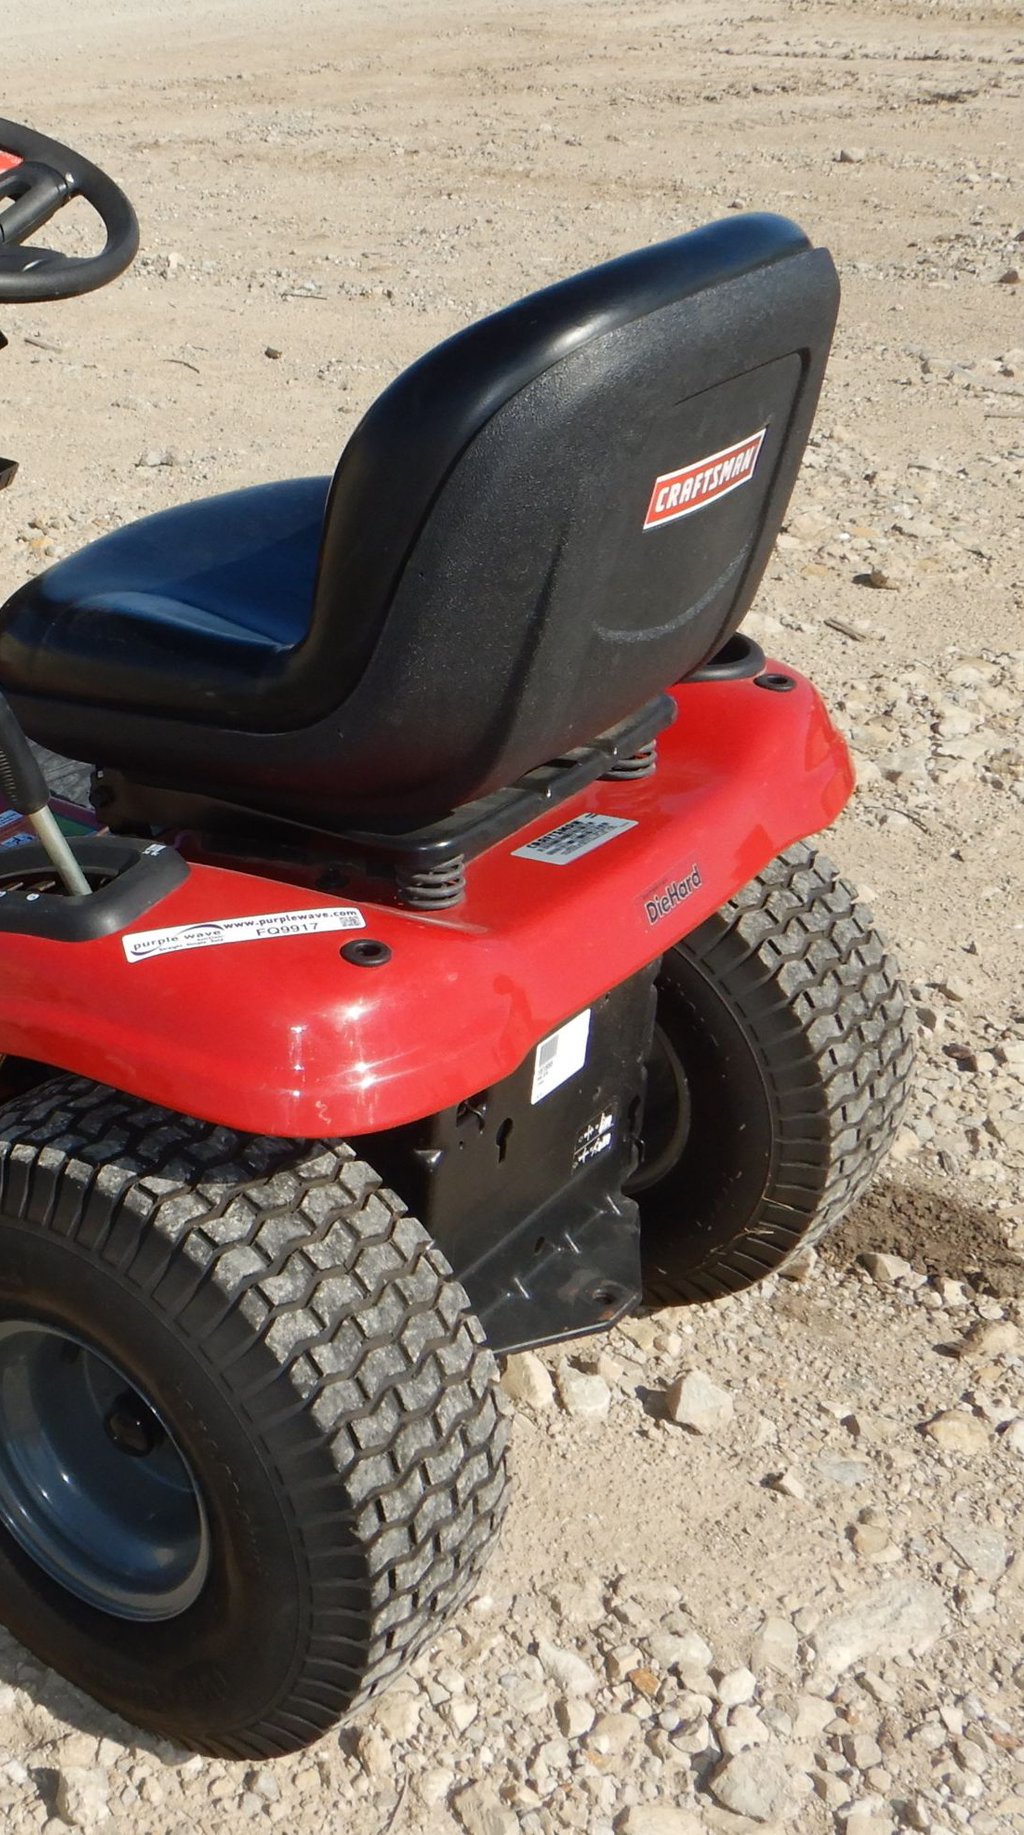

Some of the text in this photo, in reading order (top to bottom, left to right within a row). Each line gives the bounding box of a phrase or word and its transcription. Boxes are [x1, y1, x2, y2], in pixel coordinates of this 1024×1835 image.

[655, 446, 756, 513] CRAFTSMAN
[645, 864, 702, 924] DieHard
[223, 909, 358, 929] www.purplewave.com
[256, 922, 319, 936] FQ9917
[133, 935, 179, 951] purple
[184, 929, 222, 941] wave
